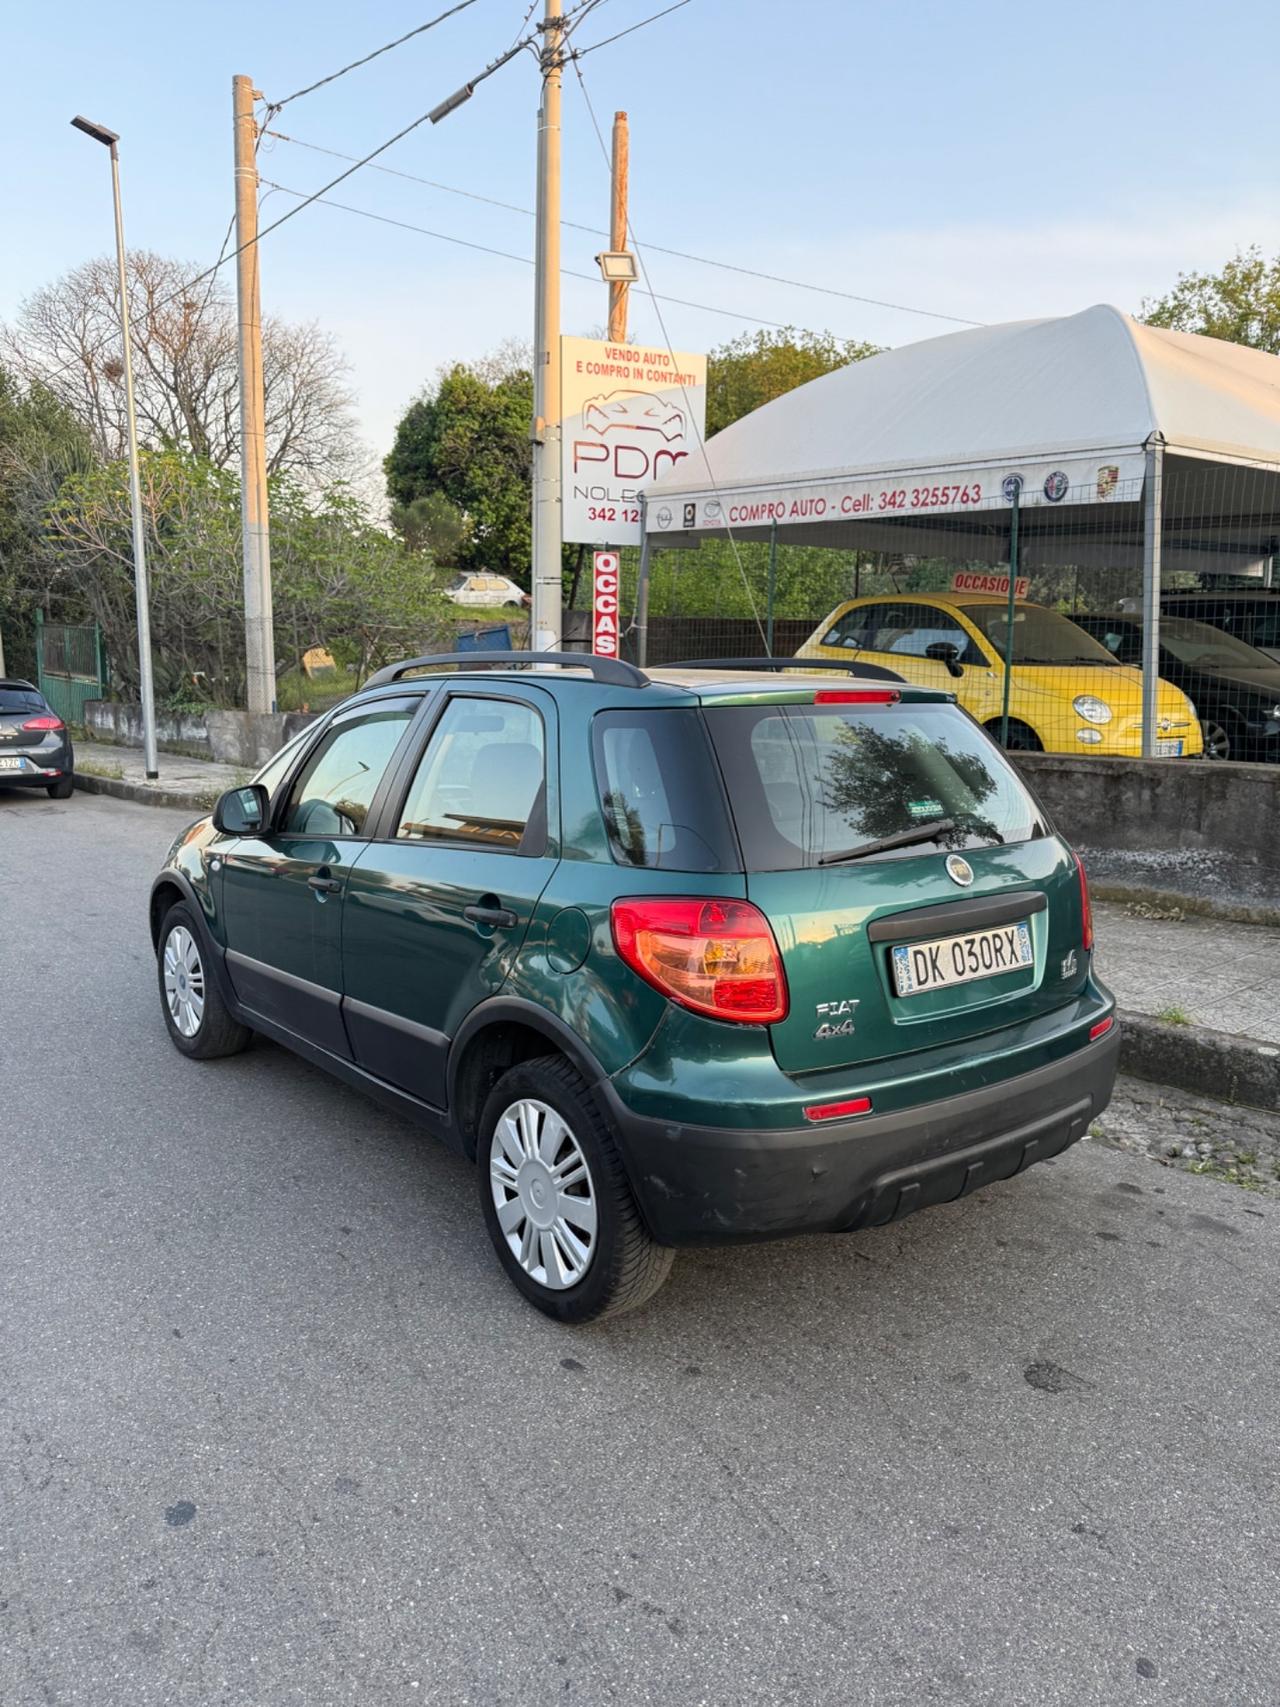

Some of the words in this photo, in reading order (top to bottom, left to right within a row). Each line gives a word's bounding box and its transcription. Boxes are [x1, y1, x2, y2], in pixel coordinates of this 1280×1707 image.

[605, 347, 640, 363] VENDO
[643, 354, 670, 367] AUTO
[576, 361, 583, 373] E
[586, 362, 630, 378] COMPRO
[633, 367, 644, 380] IN
[646, 370, 697, 387] CONTANTI
[588, 507, 616, 520] 342
[621, 509, 643, 522] 12
[729, 501, 786, 523] COMPRO
[789, 498, 827, 517] AUTO
[840, 494, 874, 514] Cell:
[878, 488, 906, 510] 342
[911, 484, 982, 508] 3255763
[596, 554, 617, 654] OCCAS
[913, 946, 945, 987] DK
[951, 930, 1019, 977] 030RX
[815, 999, 860, 1018] FIAT
[813, 1019, 856, 1041] 4x4
